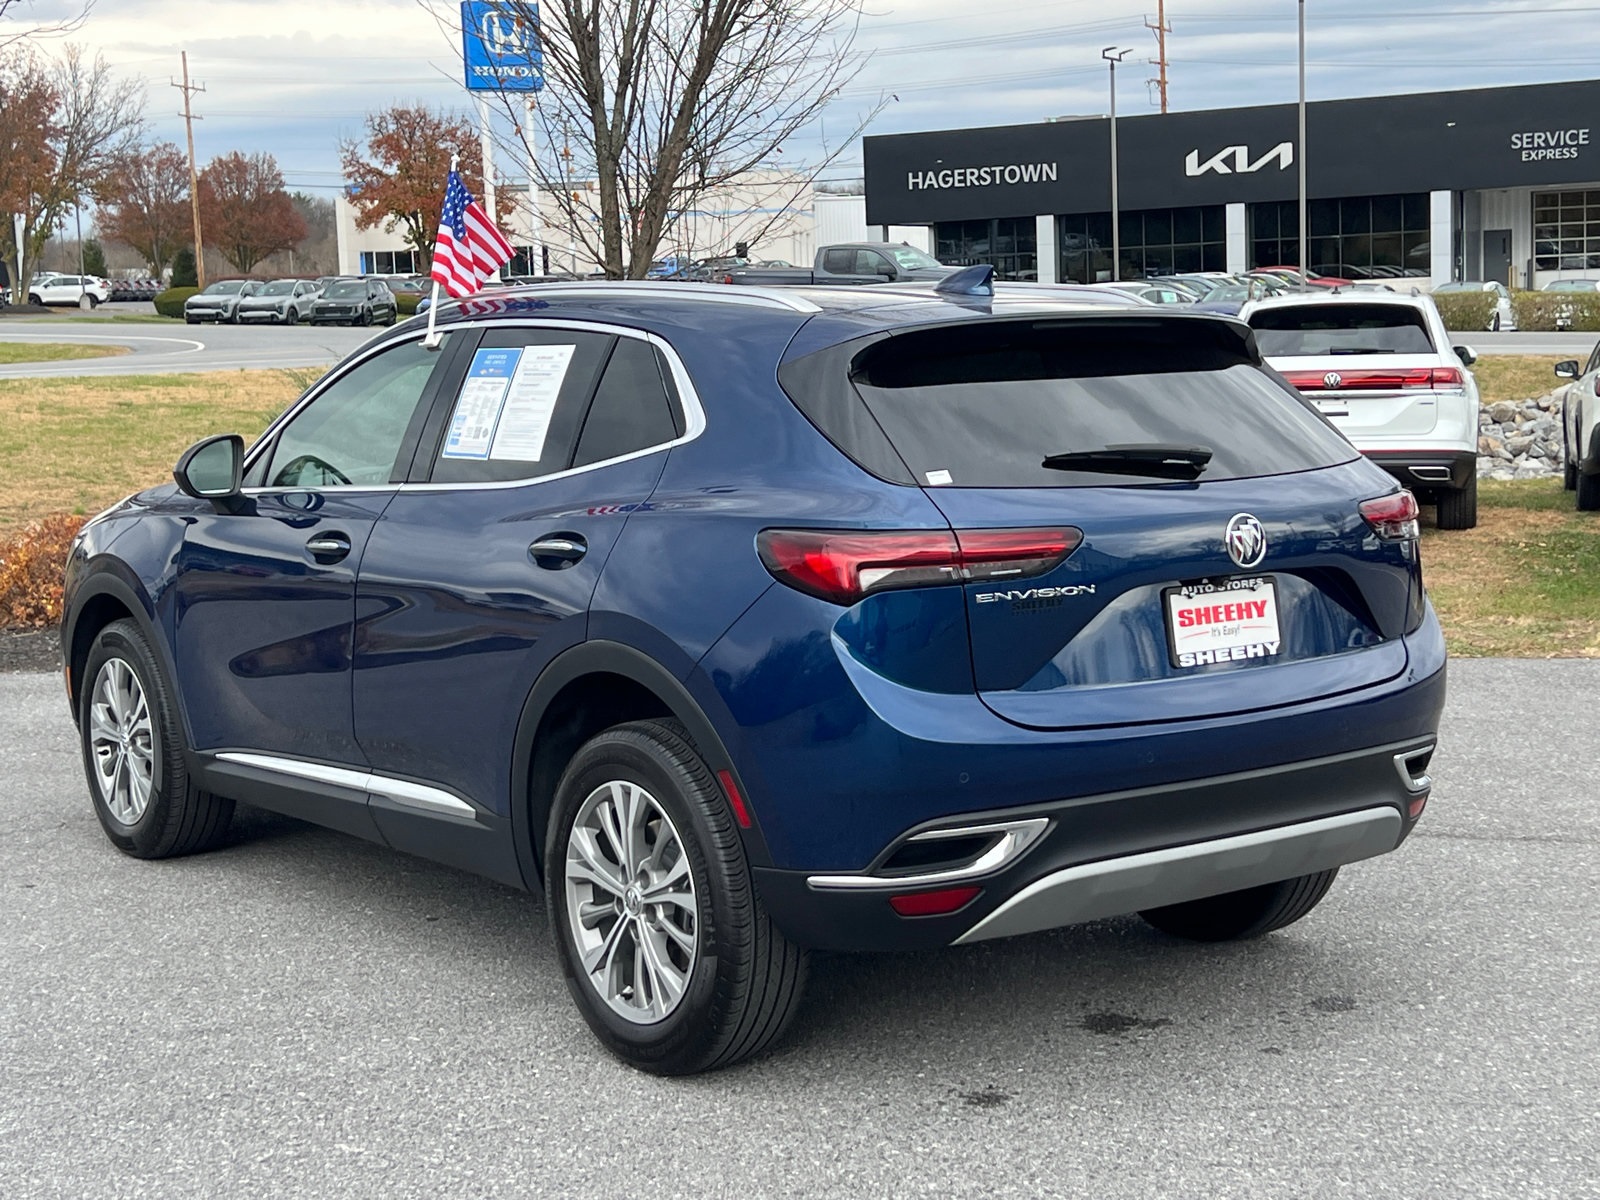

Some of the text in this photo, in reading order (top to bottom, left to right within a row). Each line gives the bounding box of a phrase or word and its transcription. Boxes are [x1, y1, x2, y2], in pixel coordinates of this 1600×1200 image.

[474, 65, 541, 77] HONDA
[1511, 129, 1590, 149] SERVICE
[1185, 141, 1293, 176] KIA
[1521, 147, 1578, 161] EXPRESS
[908, 162, 1057, 190] HAGERSTOWN
[975, 584, 1096, 604] ENVISION
[1180, 584, 1214, 596] AUTO
[1178, 600, 1267, 628] SHEEHY
[1179, 641, 1280, 667] SHEEHY
